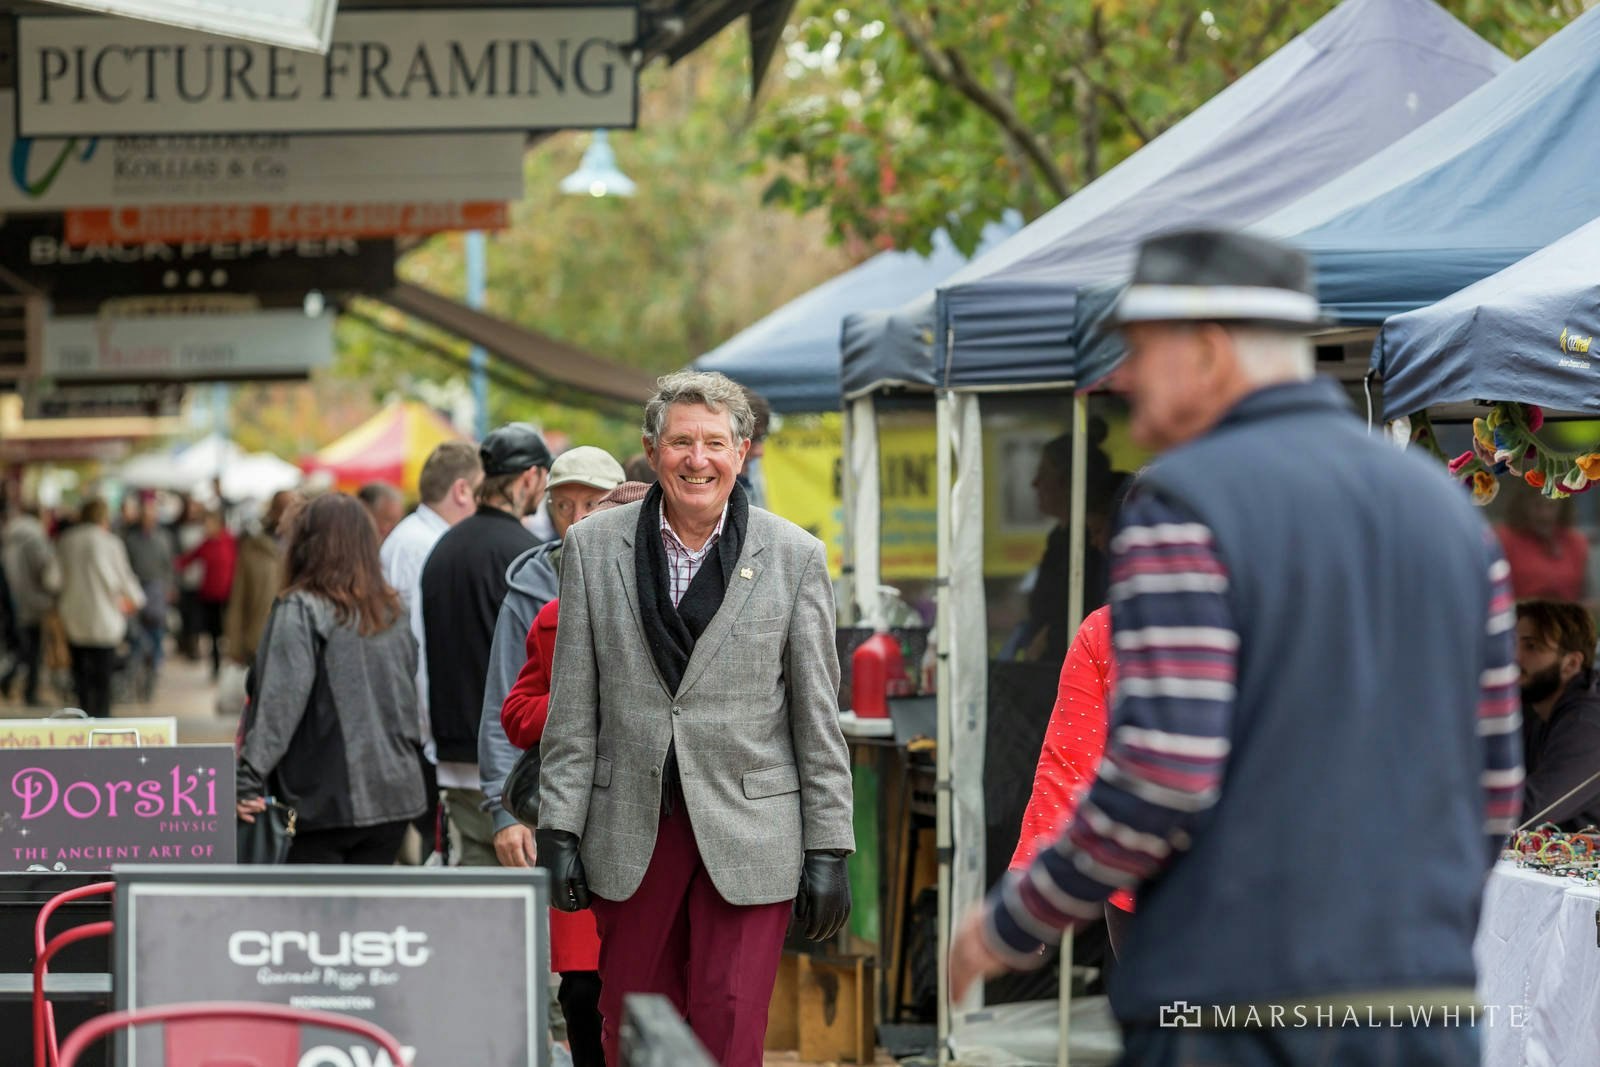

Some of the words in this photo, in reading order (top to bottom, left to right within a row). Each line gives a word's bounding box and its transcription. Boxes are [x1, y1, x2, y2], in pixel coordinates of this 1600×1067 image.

[36, 42, 299, 104] PICTURE
[321, 37, 618, 99] FRAMING
[11, 764, 218, 820] Dorski
[159, 821, 218, 833] PHYSIC
[14, 847, 49, 861] THE
[56, 846, 142, 859] ANCIENT
[149, 845, 183, 858] ART
[191, 844, 215, 857] OF
[228, 925, 430, 967] crust
